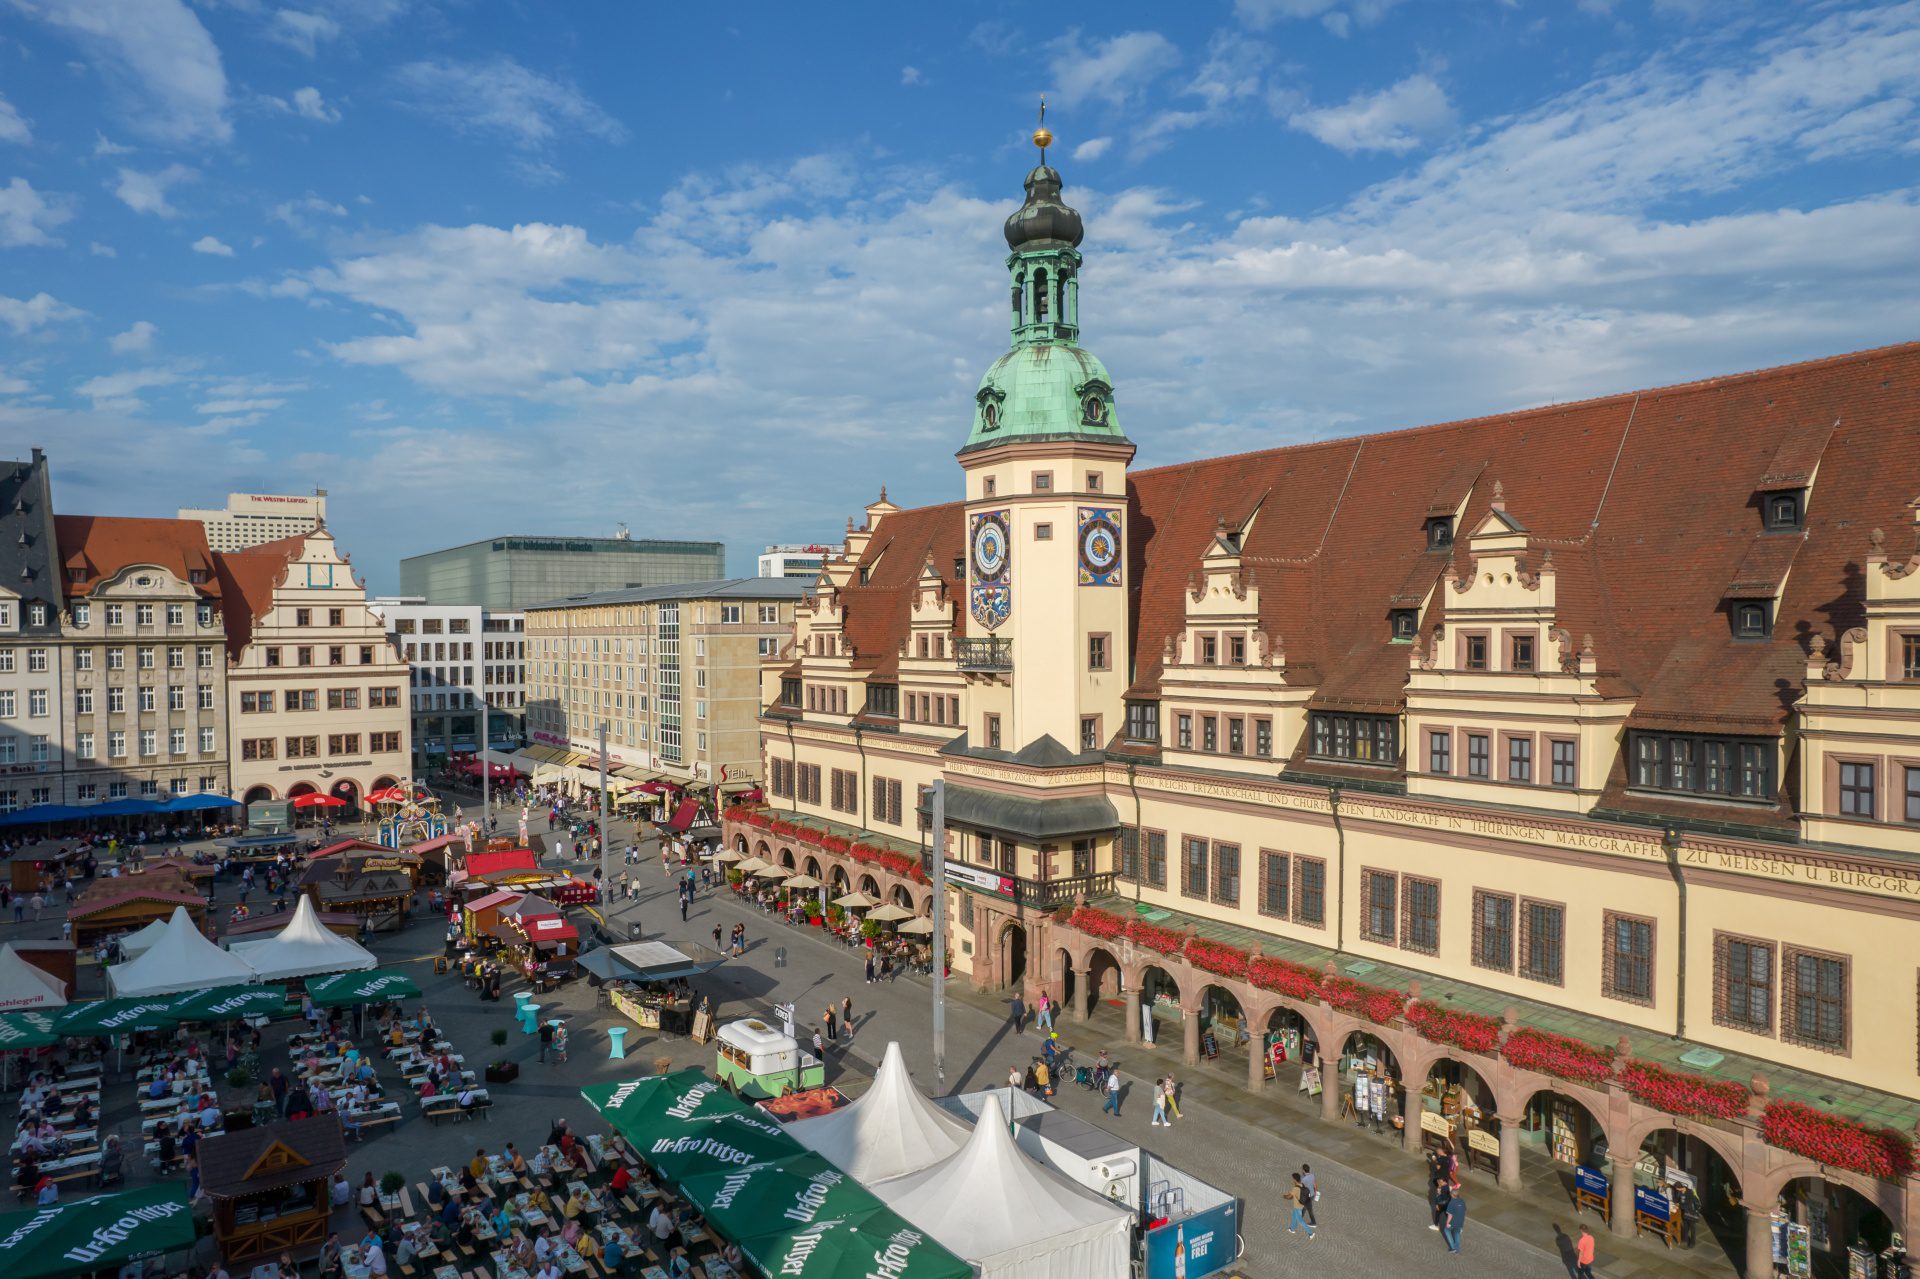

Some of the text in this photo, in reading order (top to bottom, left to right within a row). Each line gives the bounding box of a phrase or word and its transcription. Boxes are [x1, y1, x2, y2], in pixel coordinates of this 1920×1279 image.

[1047, 775, 1061, 785] ZU
[1064, 774, 1101, 784] SACHSEN
[1110, 773, 1124, 783] DES
[1159, 779, 1188, 791] REICHS
[1193, 783, 1263, 802] ERTZMARSCHALL
[1267, 793, 1289, 805] UND
[1372, 807, 1440, 826] LANDGRAFF
[1448, 817, 1462, 829] IN
[1685, 849, 1709, 864] ZU
[1719, 854, 1795, 877] MEISSEN
[775, 1007, 789, 1021] CIDER
[1191, 1243, 1208, 1260] FREI
